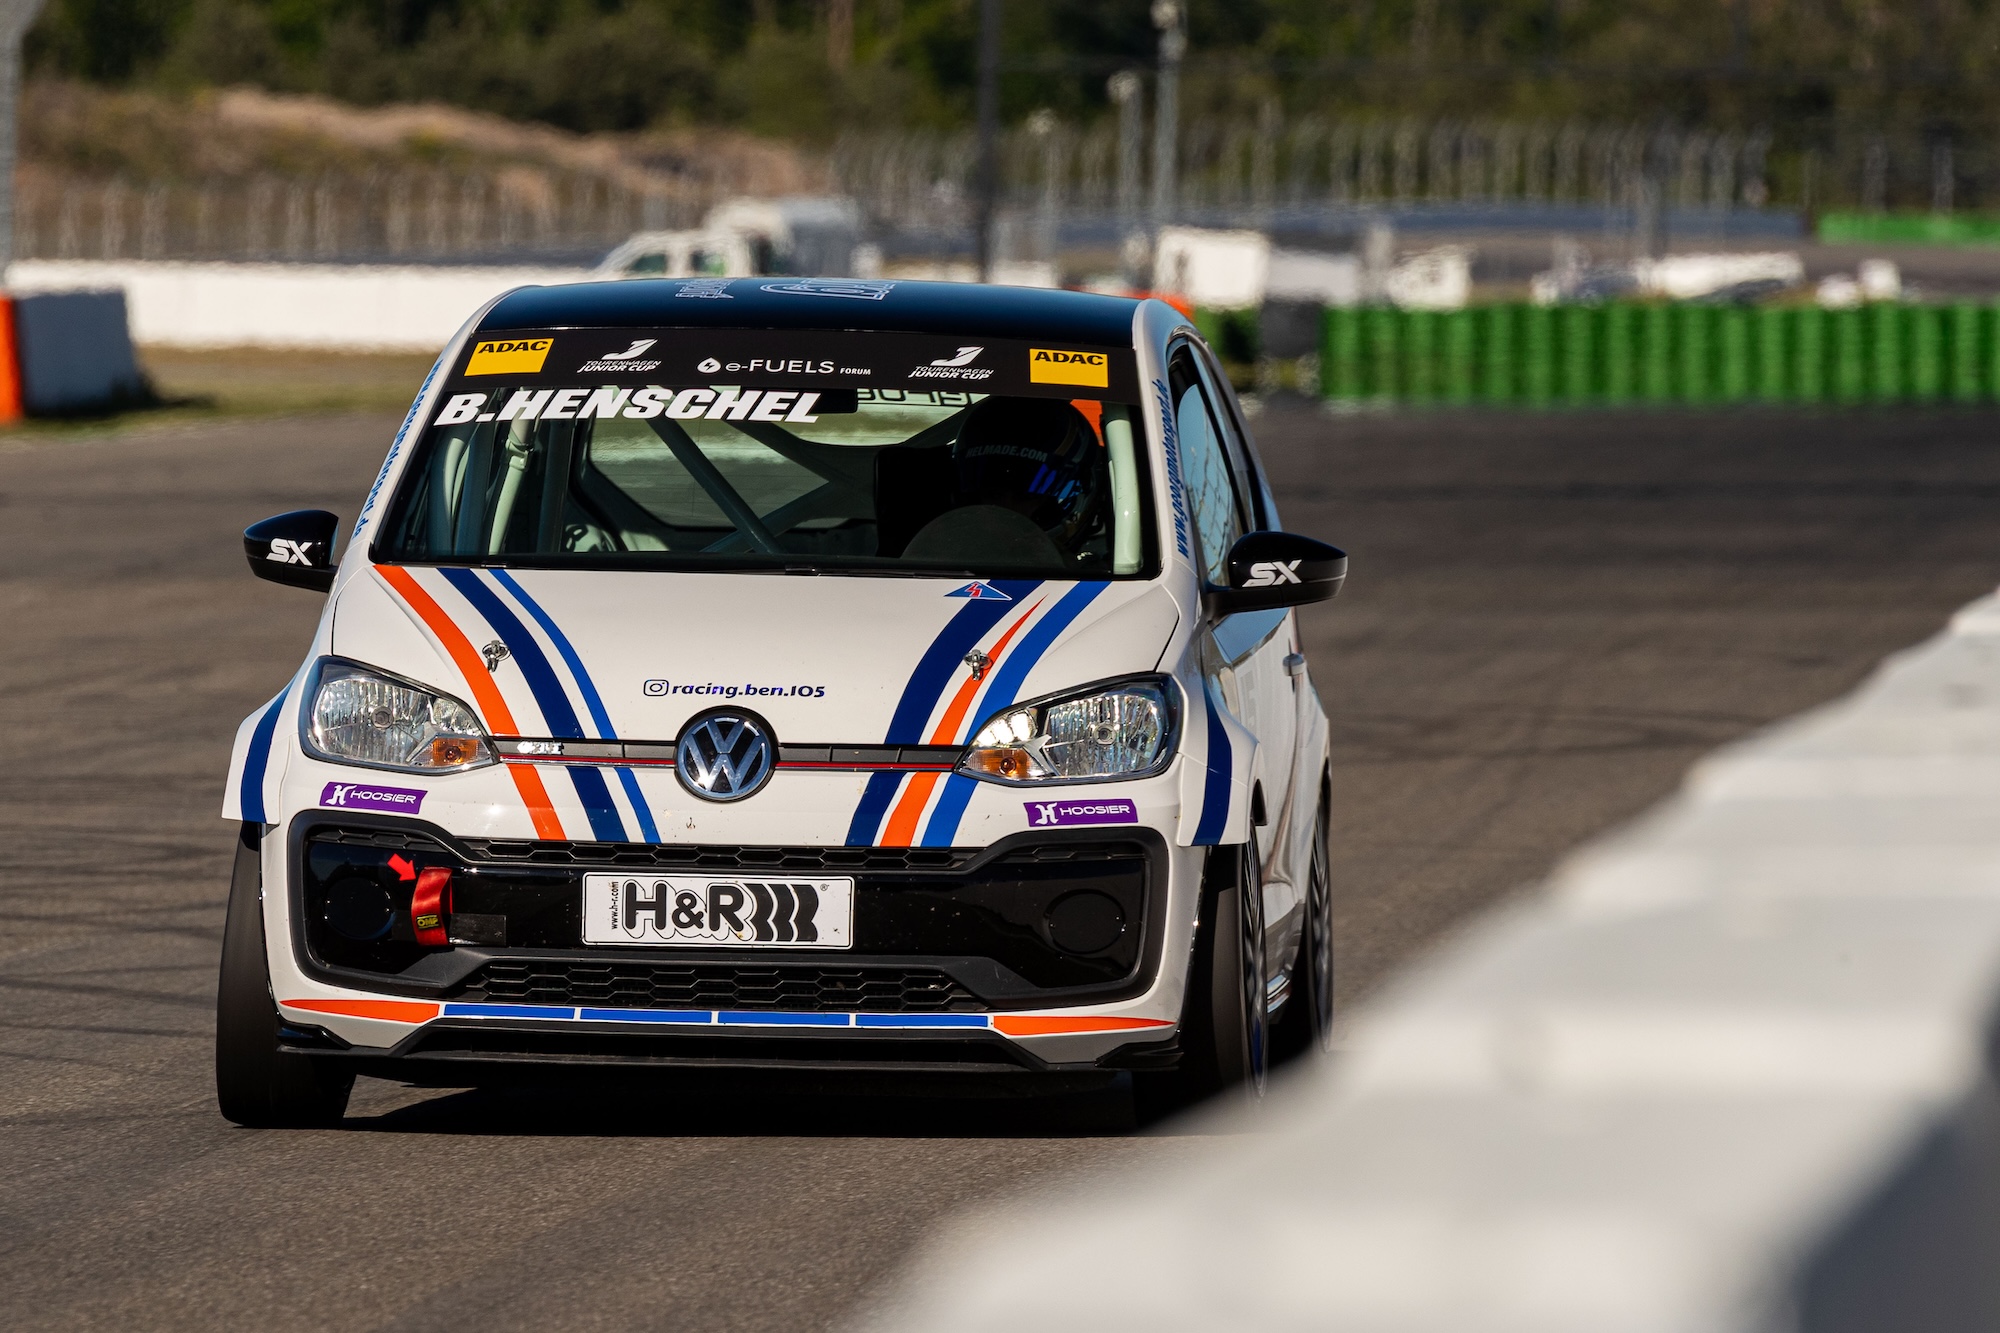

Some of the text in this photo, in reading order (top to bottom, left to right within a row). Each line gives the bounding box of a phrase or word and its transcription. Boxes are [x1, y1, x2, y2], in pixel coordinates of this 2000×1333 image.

[477, 341, 549, 354] ADAC
[725, 358, 872, 375] e-FUELS FORUM
[1034, 351, 1104, 365] ADAC
[577, 364, 658, 373] JUNIOR CUP
[908, 371, 958, 379] JUNIOR
[914, 365, 994, 375] TOURENWAGEN
[433, 387, 822, 426] B.HENSCHEL
[965, 444, 1049, 462] HELMADE.COM
[1151, 378, 1190, 560] www.georgmotorsport.de
[266, 538, 313, 566] SX
[1242, 559, 1302, 587] SX
[671, 682, 825, 699] racing.ben.105
[350, 789, 417, 804] HOOSIER
[1060, 805, 1131, 816] HOOSIER
[609, 881, 619, 930] www.h-r.com
[624, 882, 744, 932] H&R
[416, 916, 439, 928] OMP
